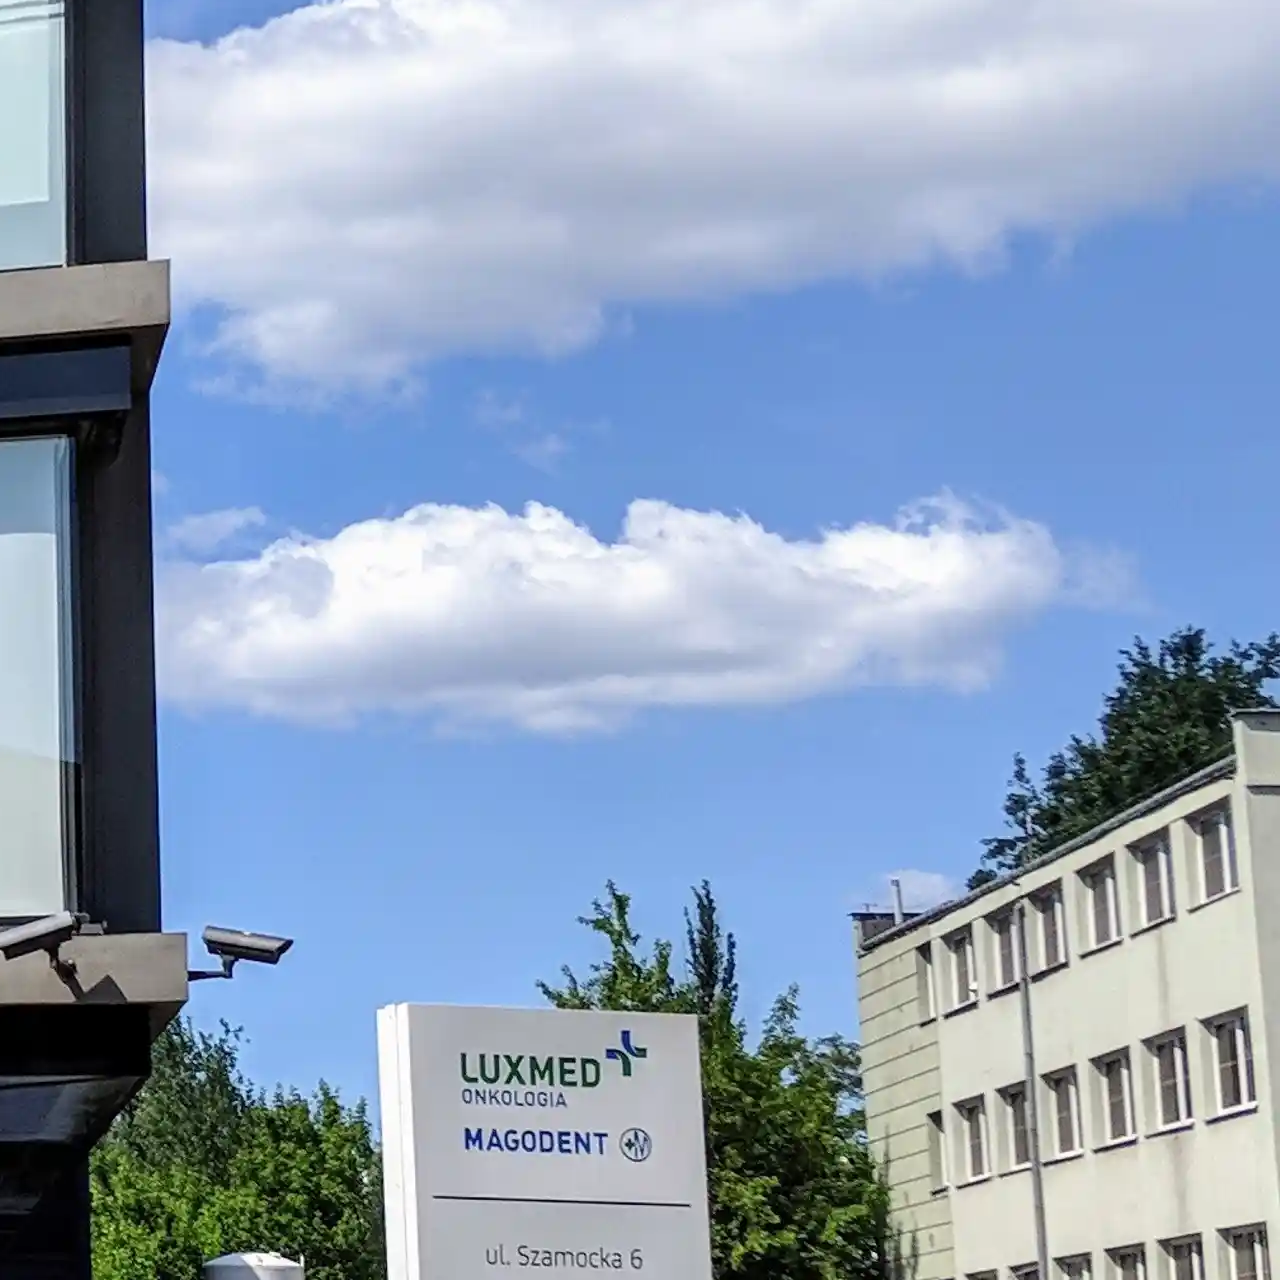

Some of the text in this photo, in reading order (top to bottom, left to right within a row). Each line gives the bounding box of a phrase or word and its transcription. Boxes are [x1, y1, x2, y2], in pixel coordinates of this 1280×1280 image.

[460, 1052, 601, 1087] LUXMED
[461, 1088, 567, 1107] ONKOLOGIA
[464, 1127, 609, 1154] MAGODENT
[485, 1243, 643, 1269] ul. Szamocka 6
